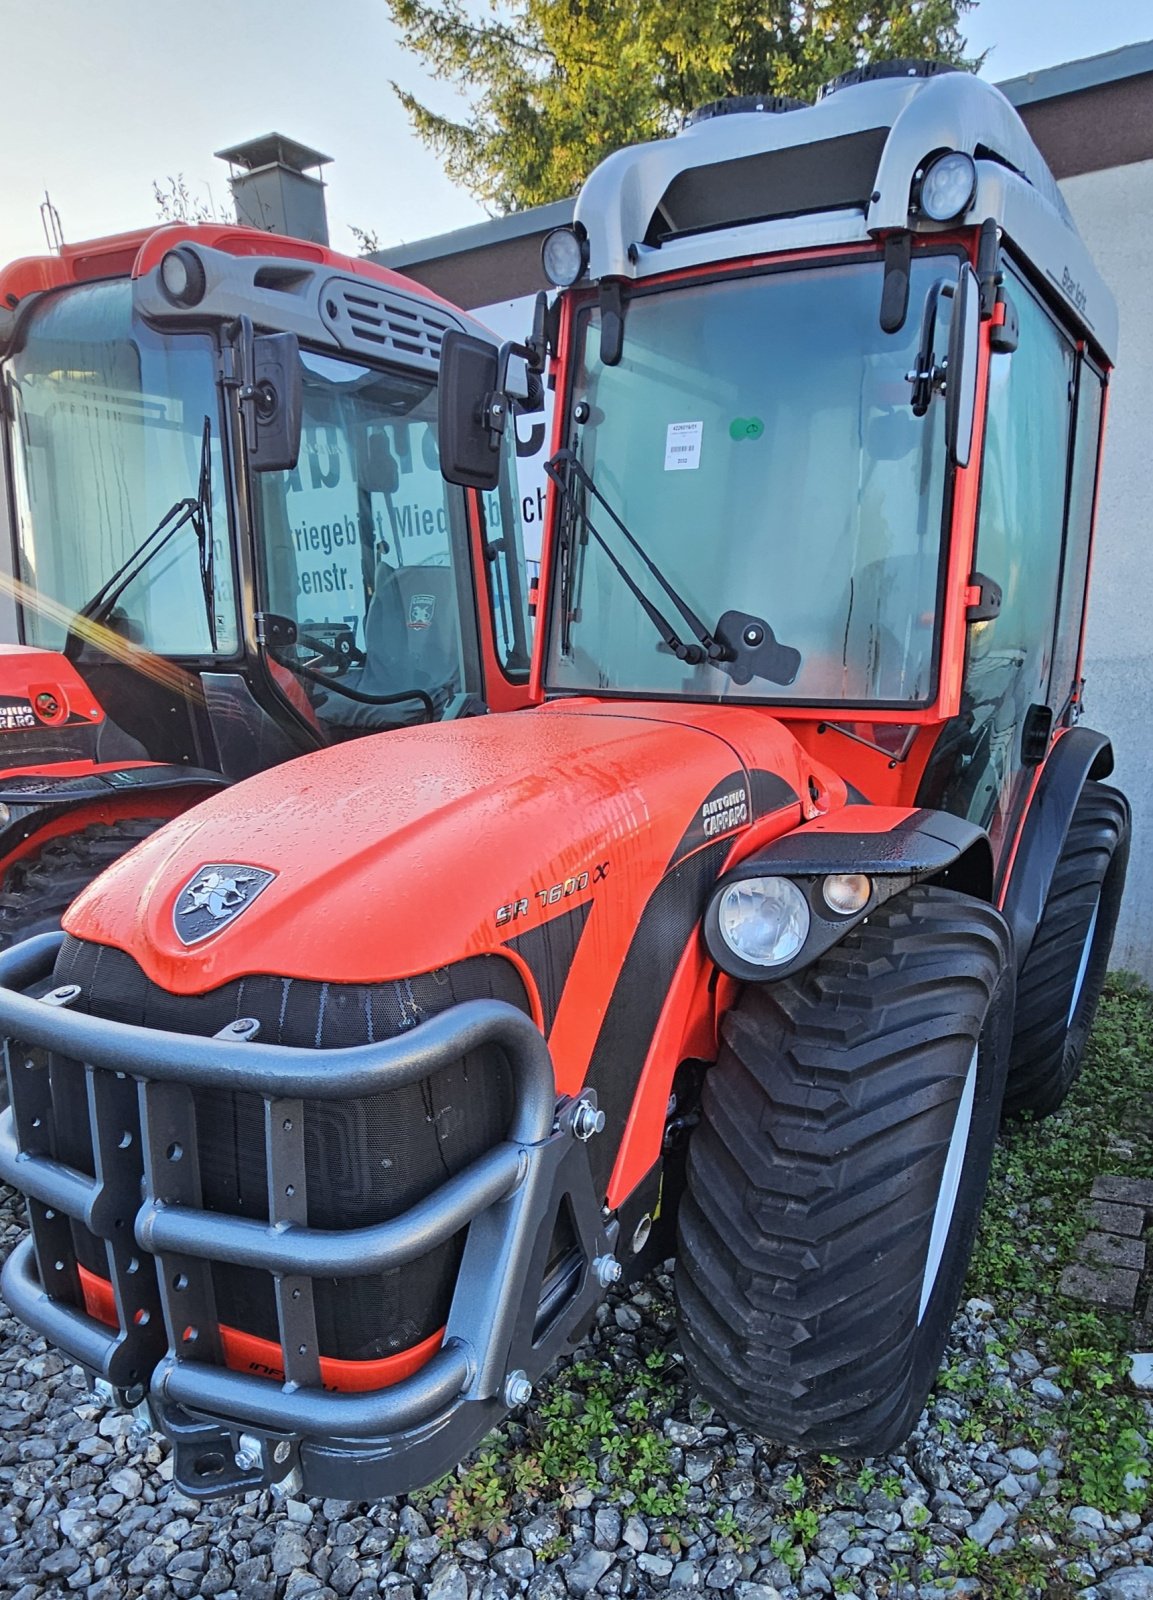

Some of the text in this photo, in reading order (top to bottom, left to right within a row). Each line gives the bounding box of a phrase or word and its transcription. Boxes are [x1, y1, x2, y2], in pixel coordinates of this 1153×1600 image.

[702, 788, 746, 817] ANTONIO
[703, 803, 748, 839] CARRARO
[495, 897, 529, 928] SR
[534, 871, 589, 908] 7600
